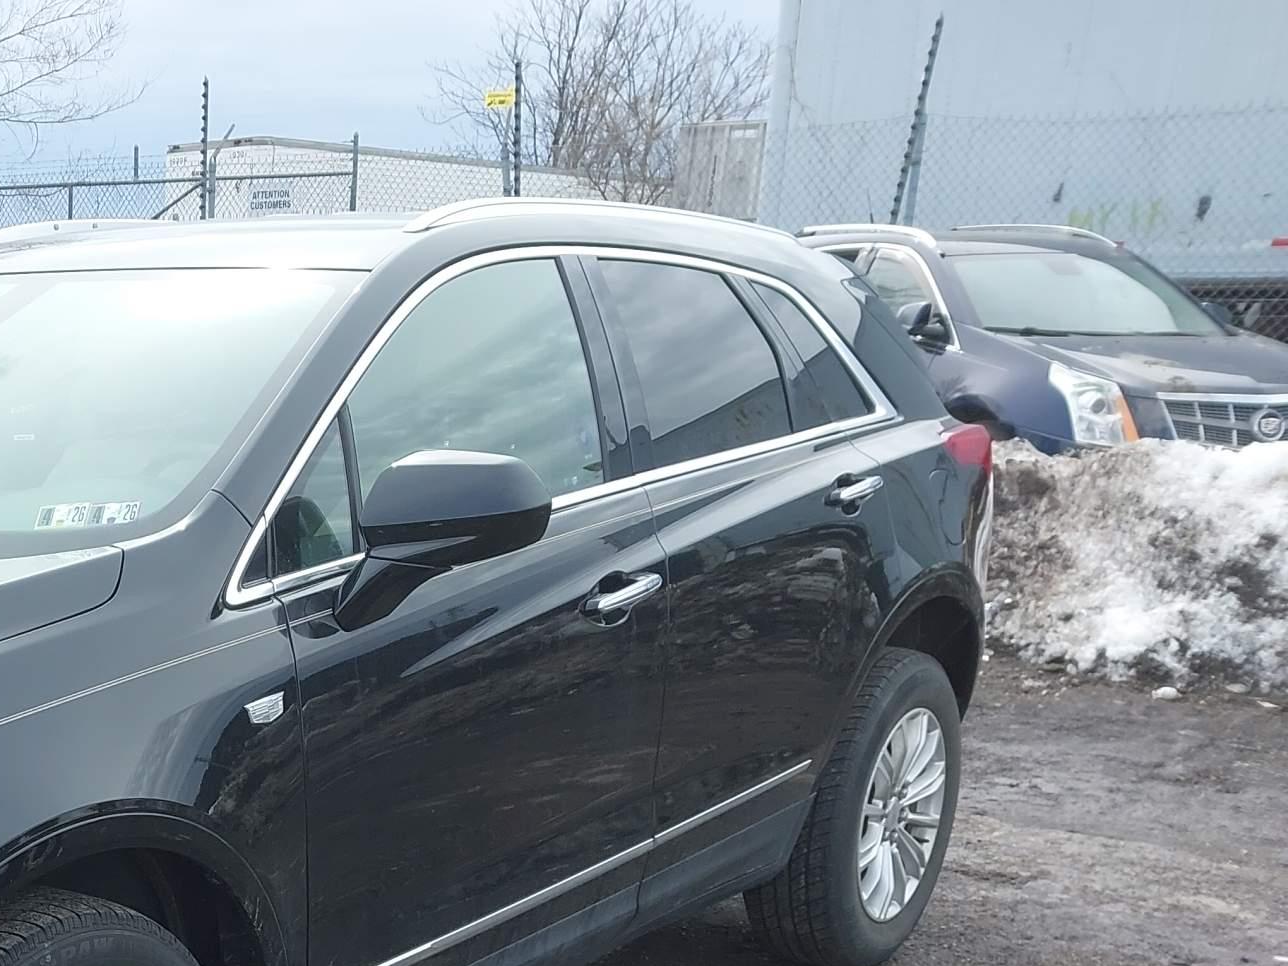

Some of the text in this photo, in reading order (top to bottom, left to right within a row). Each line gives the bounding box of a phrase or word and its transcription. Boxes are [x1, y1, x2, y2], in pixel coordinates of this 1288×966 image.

[252, 189, 290, 200] ATTENTION
[250, 199, 292, 210] CUSTOMERS
[123, 503, 139, 521] 26
